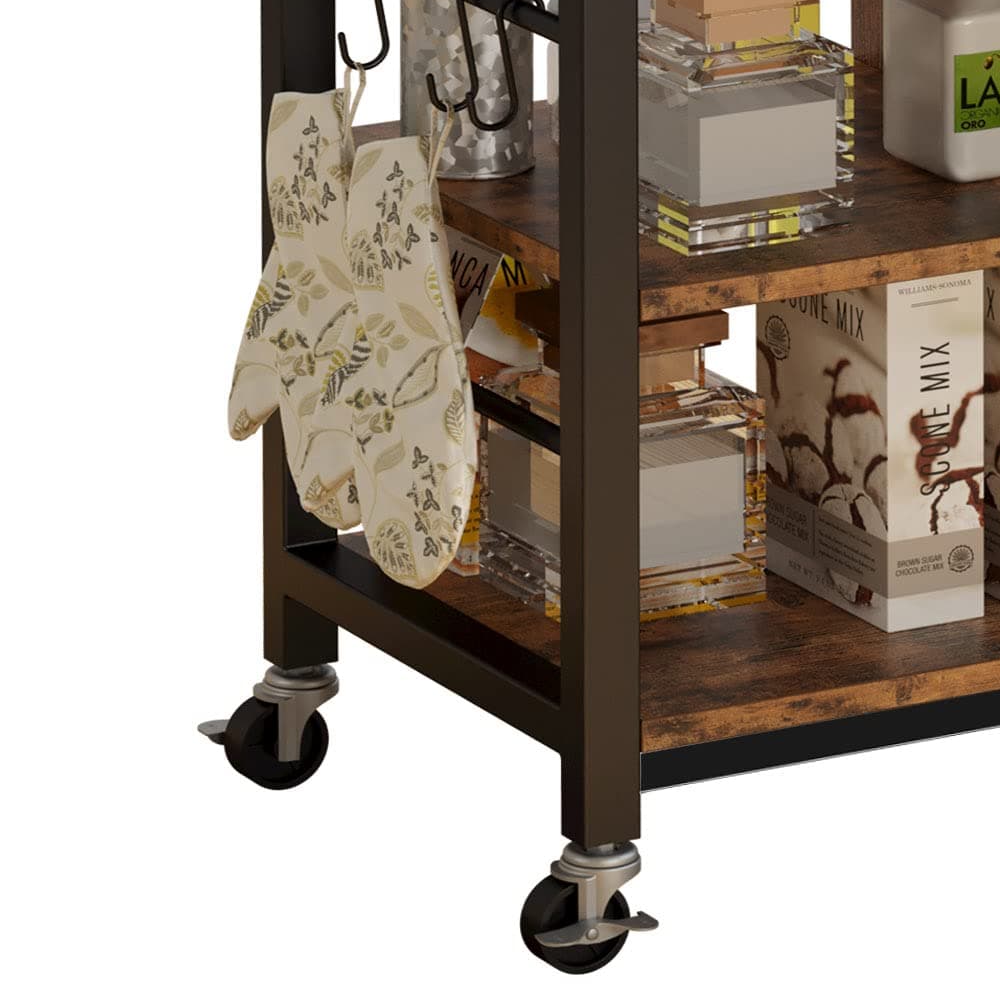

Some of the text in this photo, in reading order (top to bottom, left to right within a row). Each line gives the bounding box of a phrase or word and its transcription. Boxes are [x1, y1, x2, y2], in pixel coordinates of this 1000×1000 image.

[960, 119, 986, 130] ORO
[836, 298, 864, 341] MIX
[920, 342, 950, 496] SCONE MIX
[897, 557, 920, 569] BROWN
[921, 553, 943, 564] SUGAR
[895, 565, 931, 577] CHOCOLATE
[932, 562, 944, 571] MIX
